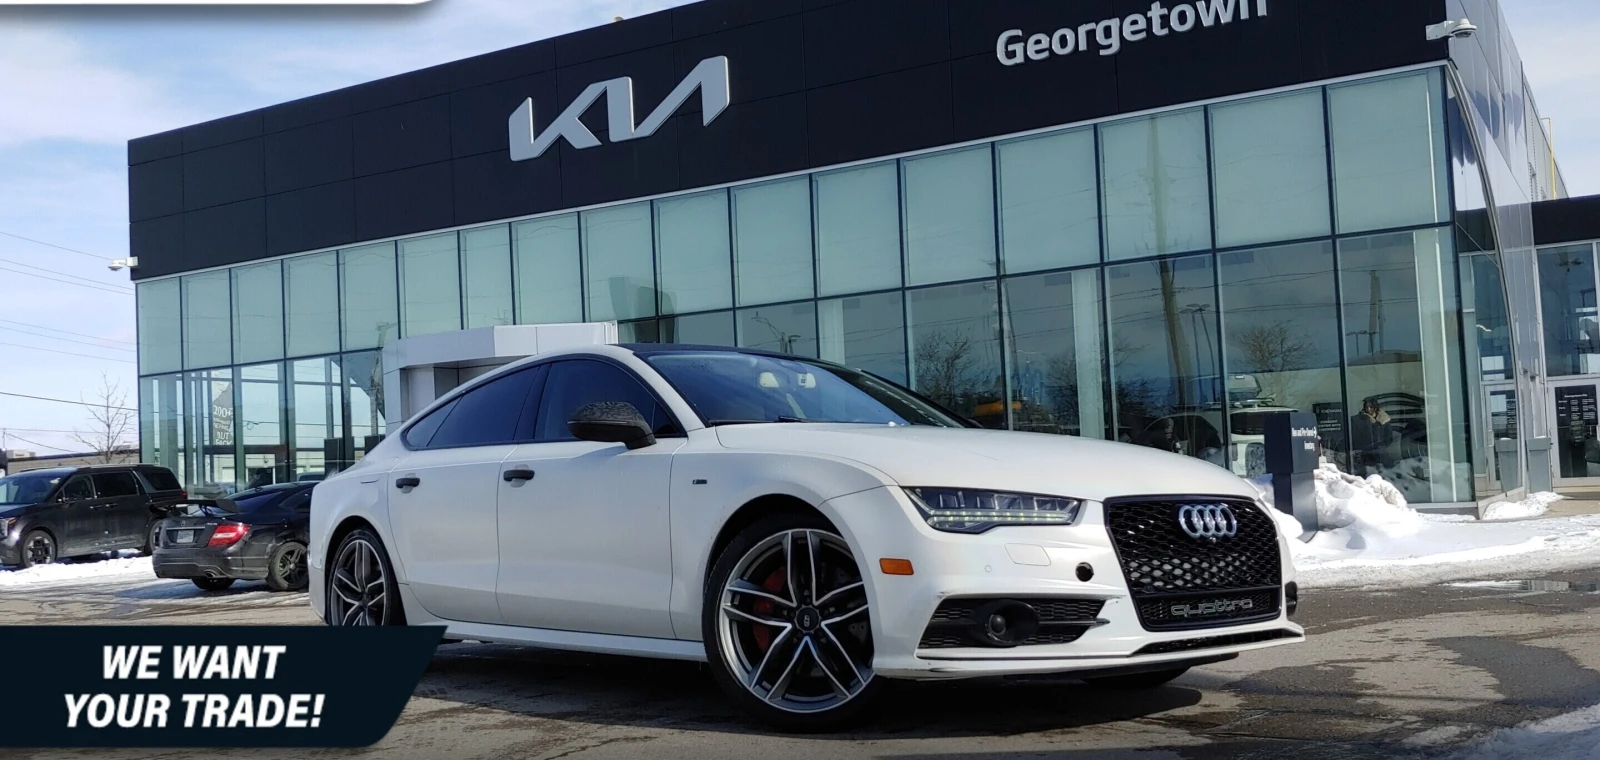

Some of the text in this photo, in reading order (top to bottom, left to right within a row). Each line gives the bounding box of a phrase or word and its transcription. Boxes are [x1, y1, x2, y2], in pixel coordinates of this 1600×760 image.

[996, 0, 1267, 66] Georgetown
[508, 55, 730, 162] KIA
[1171, 599, 1253, 618] quattro
